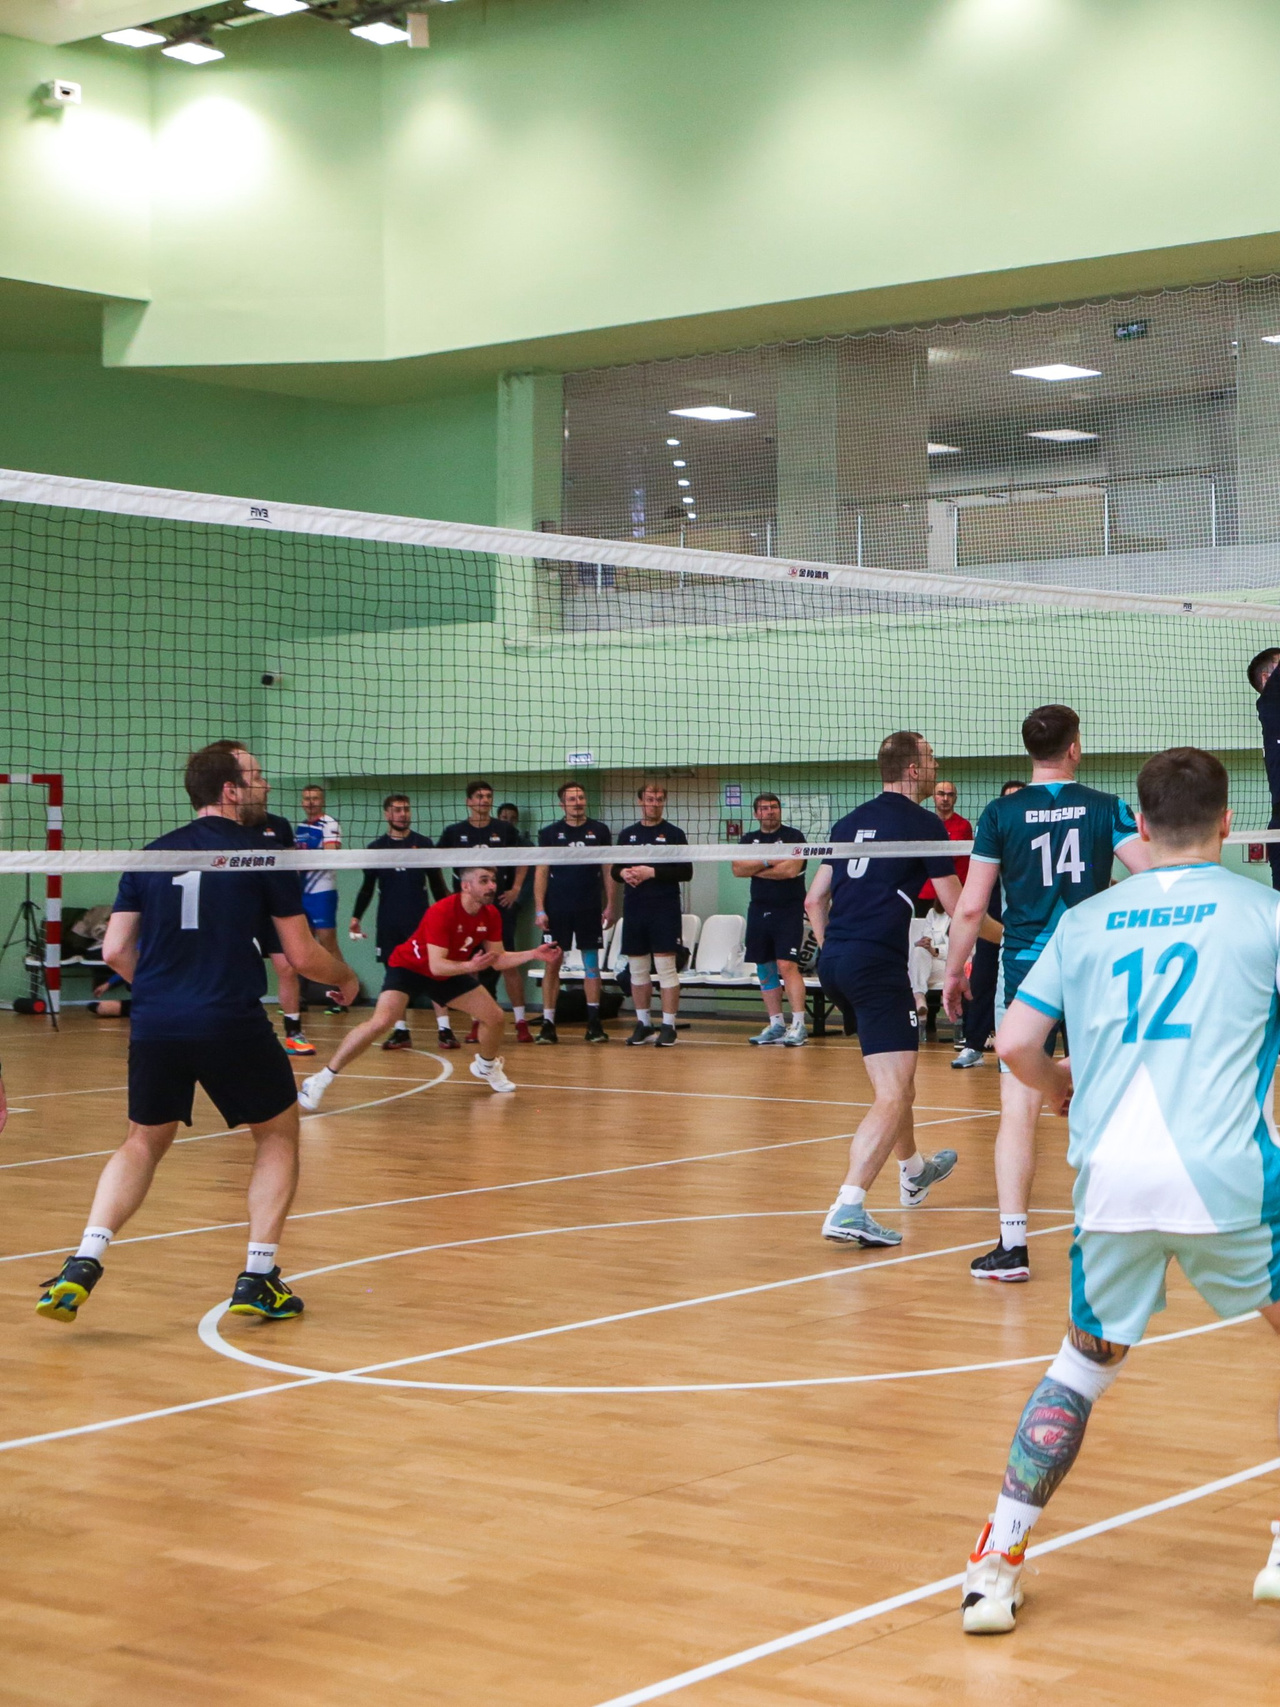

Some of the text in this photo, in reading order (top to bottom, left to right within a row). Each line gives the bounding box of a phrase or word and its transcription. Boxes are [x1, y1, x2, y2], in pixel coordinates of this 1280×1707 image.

[250, 506, 269, 518] FIVB
[1025, 806, 1086, 823] СИБУР
[1031, 828, 1085, 887] 14
[171, 870, 202, 930] 1
[1105, 902, 1218, 931] СИБУР
[459, 936, 474, 952] 2
[1112, 941, 1199, 1044] 12
[909, 1010, 918, 1027] 5
